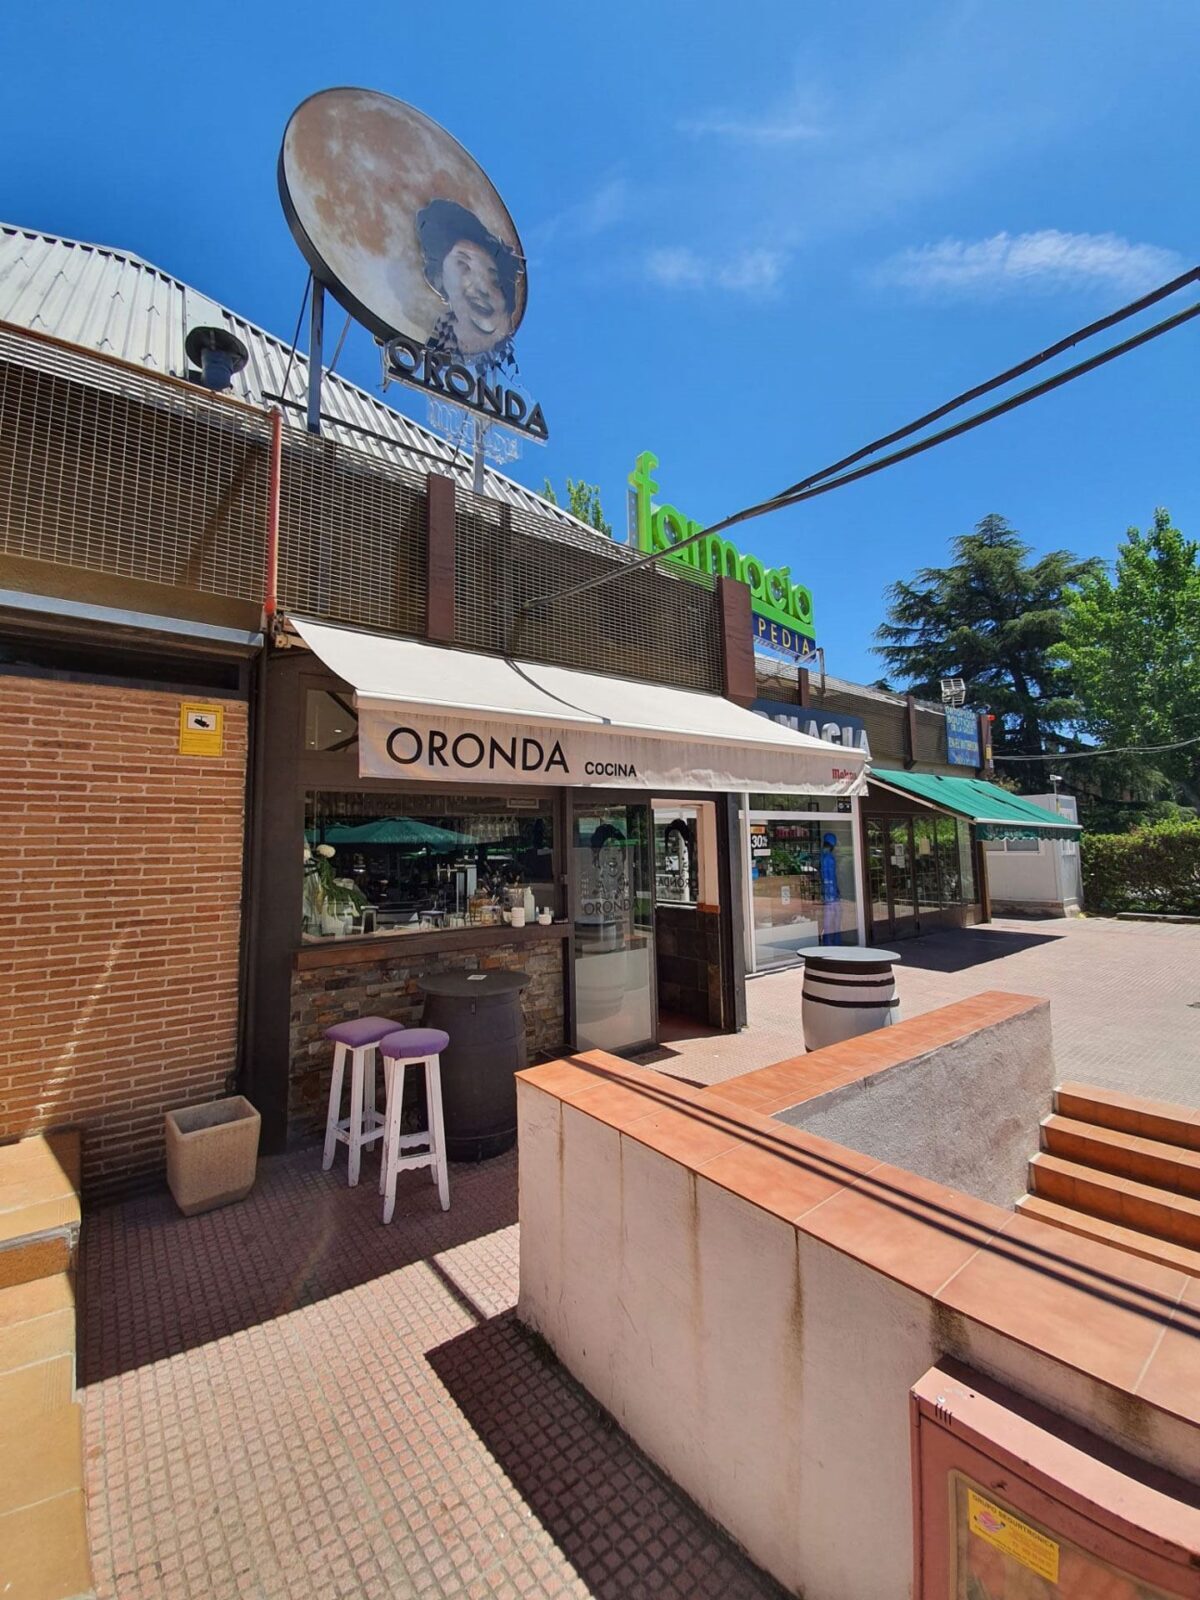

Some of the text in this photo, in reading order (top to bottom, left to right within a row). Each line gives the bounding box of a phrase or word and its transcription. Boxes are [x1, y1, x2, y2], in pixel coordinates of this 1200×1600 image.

[388, 336, 549, 439] ORONDA
[386, 727, 637, 777] ORONDA COCINA
[583, 899, 640, 916] ORONDA
